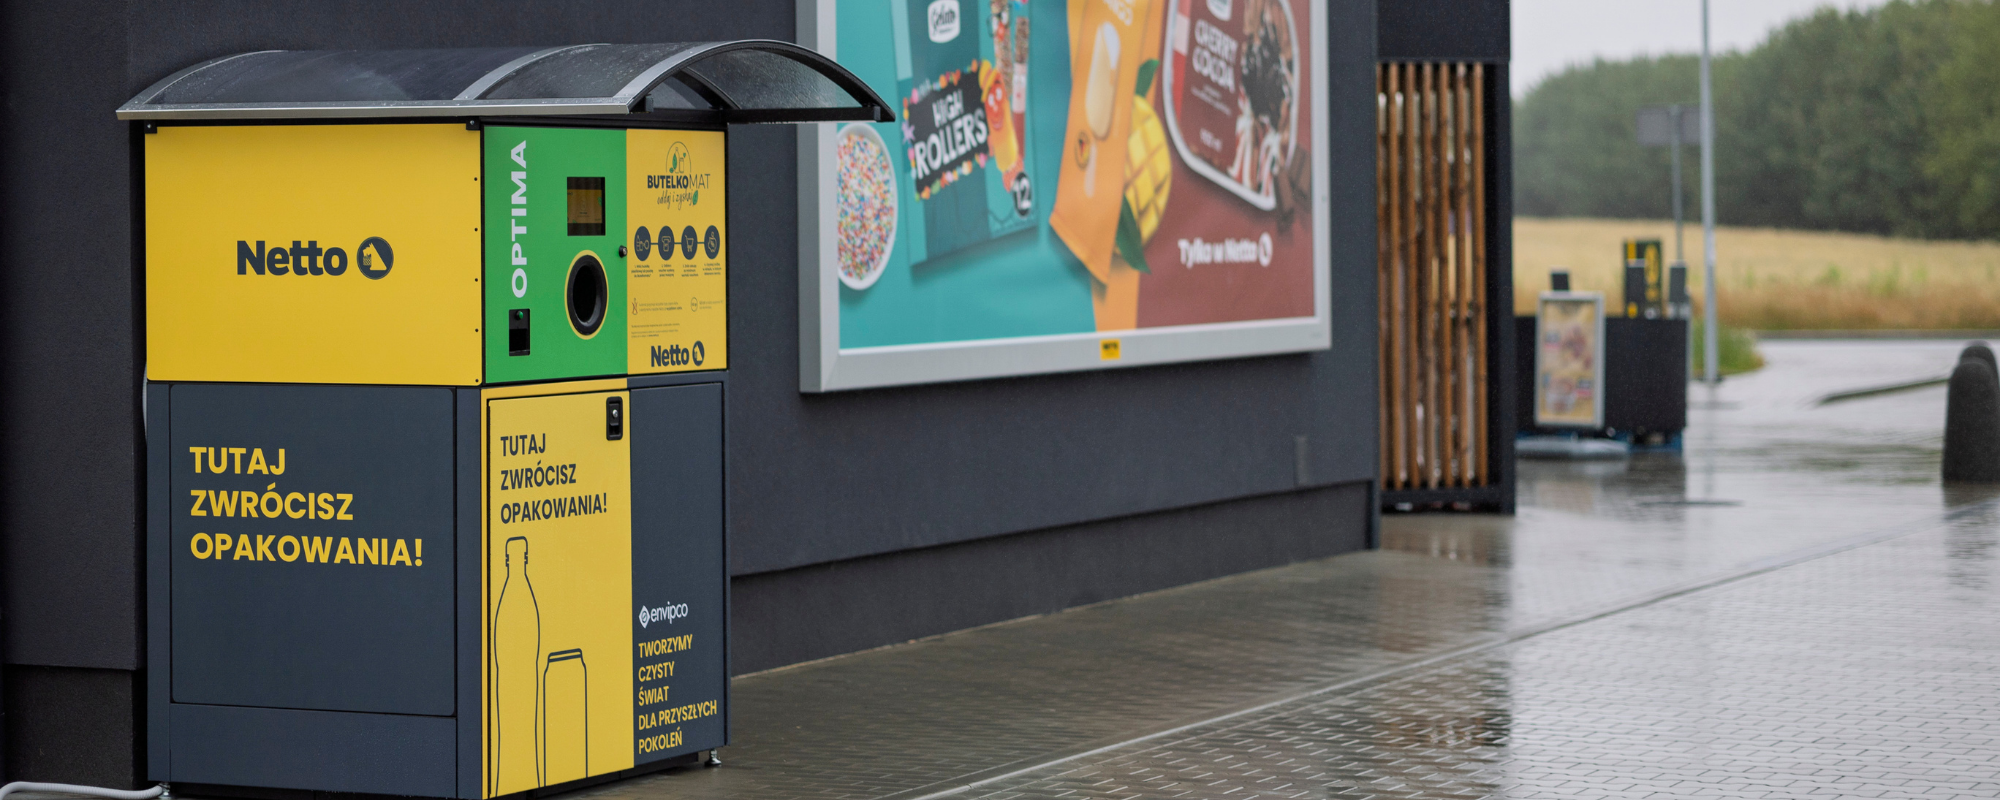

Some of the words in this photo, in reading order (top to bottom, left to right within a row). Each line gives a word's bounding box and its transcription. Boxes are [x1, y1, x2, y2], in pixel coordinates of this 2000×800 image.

[1194, 19, 1239, 64] CHERRY
[1192, 46, 1236, 94] COCOA
[932, 89, 964, 128] HIGH
[914, 108, 988, 179] ROLLERS
[647, 173, 710, 189] BUTELKOMAT
[1013, 177, 1031, 209] 12
[511, 140, 528, 298] OPTIMA
[237, 240, 348, 276] Netto
[1224, 238, 1257, 263] Netto
[651, 345, 690, 368] Netto
[500, 433, 546, 457] TUTAJ
[189, 446, 286, 475] TUTAJ
[501, 460, 577, 491] ZWRÓCISZ
[190, 482, 354, 521] ZWRÓCISZ
[501, 493, 608, 524] OPAKOWANIA!
[190, 533, 423, 567] OPAKOWANIA!
[650, 601, 689, 624] envipco
[639, 634, 693, 658] TWORZYMY
[639, 661, 675, 682] CZYSTY
[639, 685, 669, 707] ŚWIAT
[639, 709, 656, 730] DLA
[658, 700, 717, 728] PRZYSZŁYCH
[639, 728, 683, 755] POKOLEŃ
